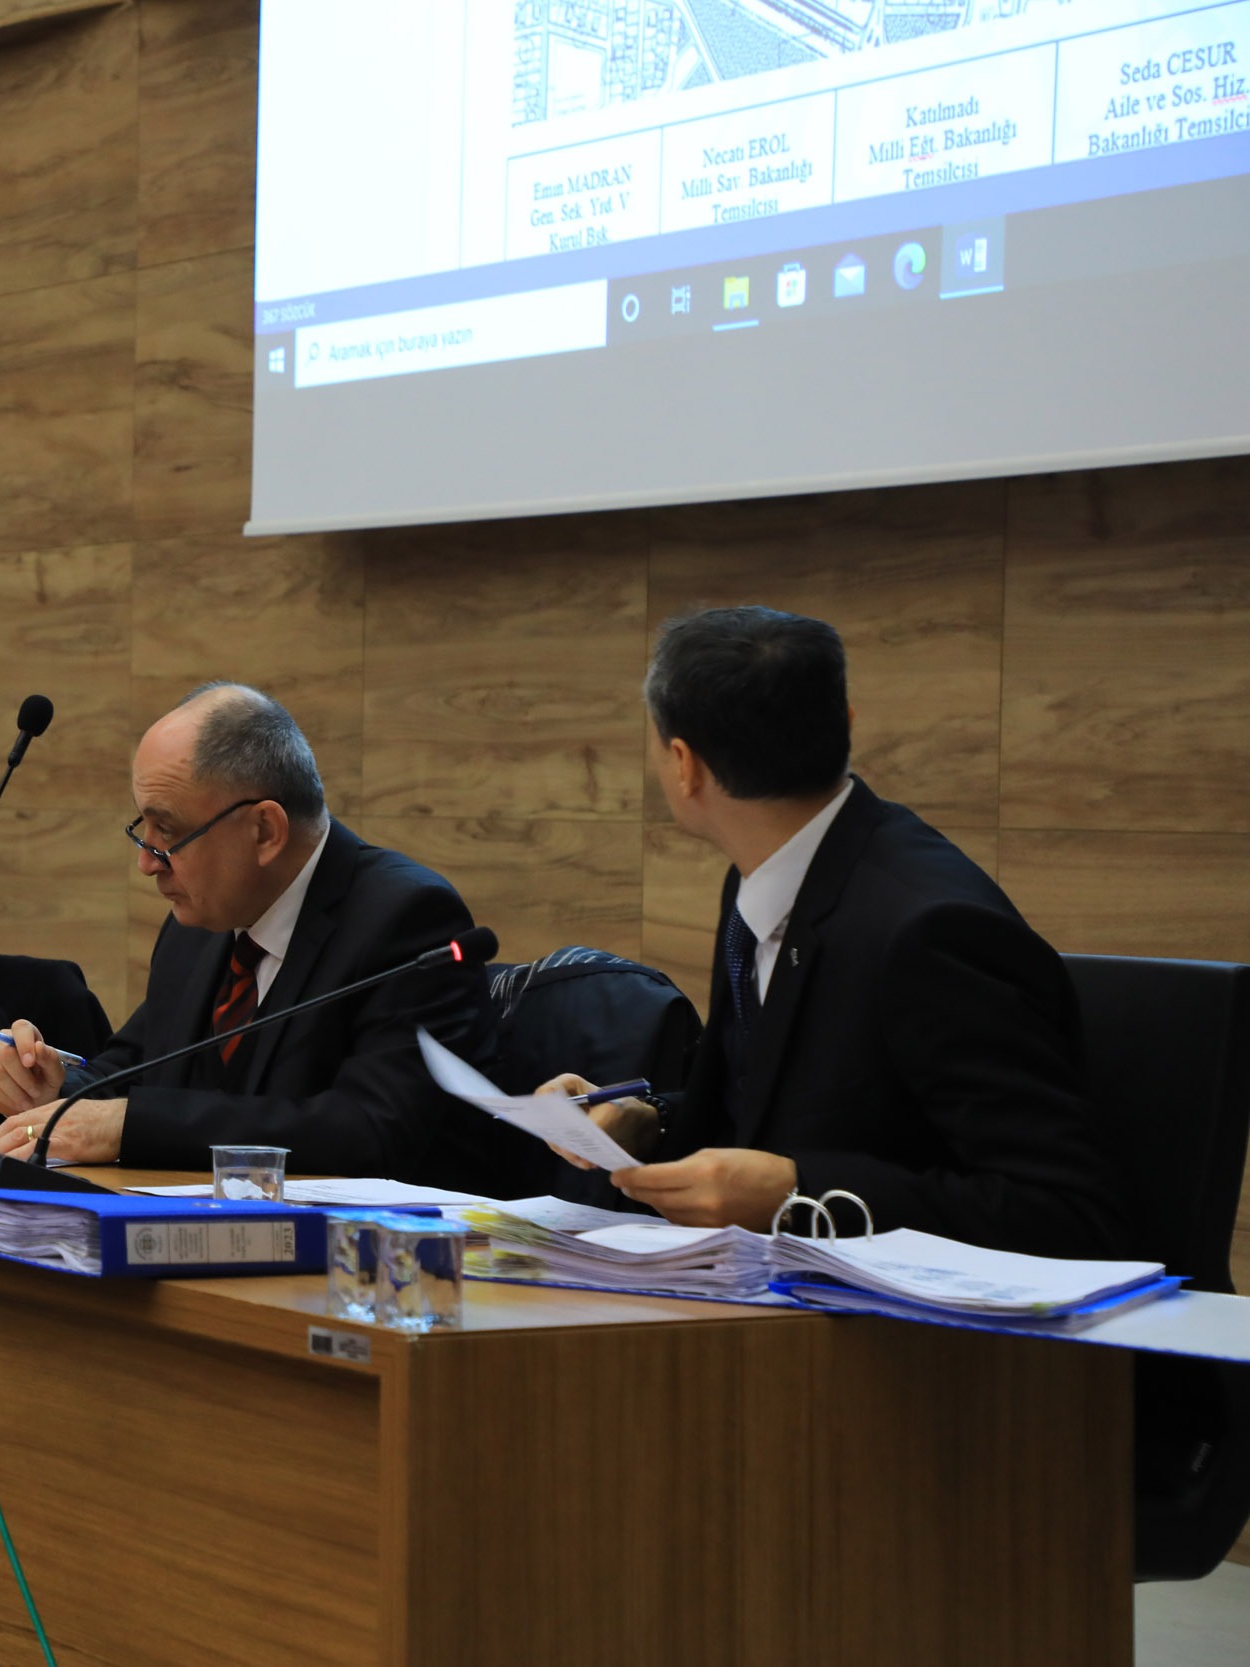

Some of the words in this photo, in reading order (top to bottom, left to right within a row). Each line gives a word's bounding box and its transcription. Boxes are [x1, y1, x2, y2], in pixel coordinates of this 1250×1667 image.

[1120, 58, 1161, 85] Seda
[1167, 41, 1238, 75] CESUR
[1104, 95, 1140, 120] Aile
[1146, 92, 1166, 112] ve
[1172, 84, 1207, 107] Sos.
[1213, 73, 1250, 99] Hiz.
[749, 133, 791, 159] EROL
[943, 119, 1018, 151] Bakanlığı
[1088, 123, 1169, 156] Bakanlığı
[567, 163, 632, 195] MADRAN
